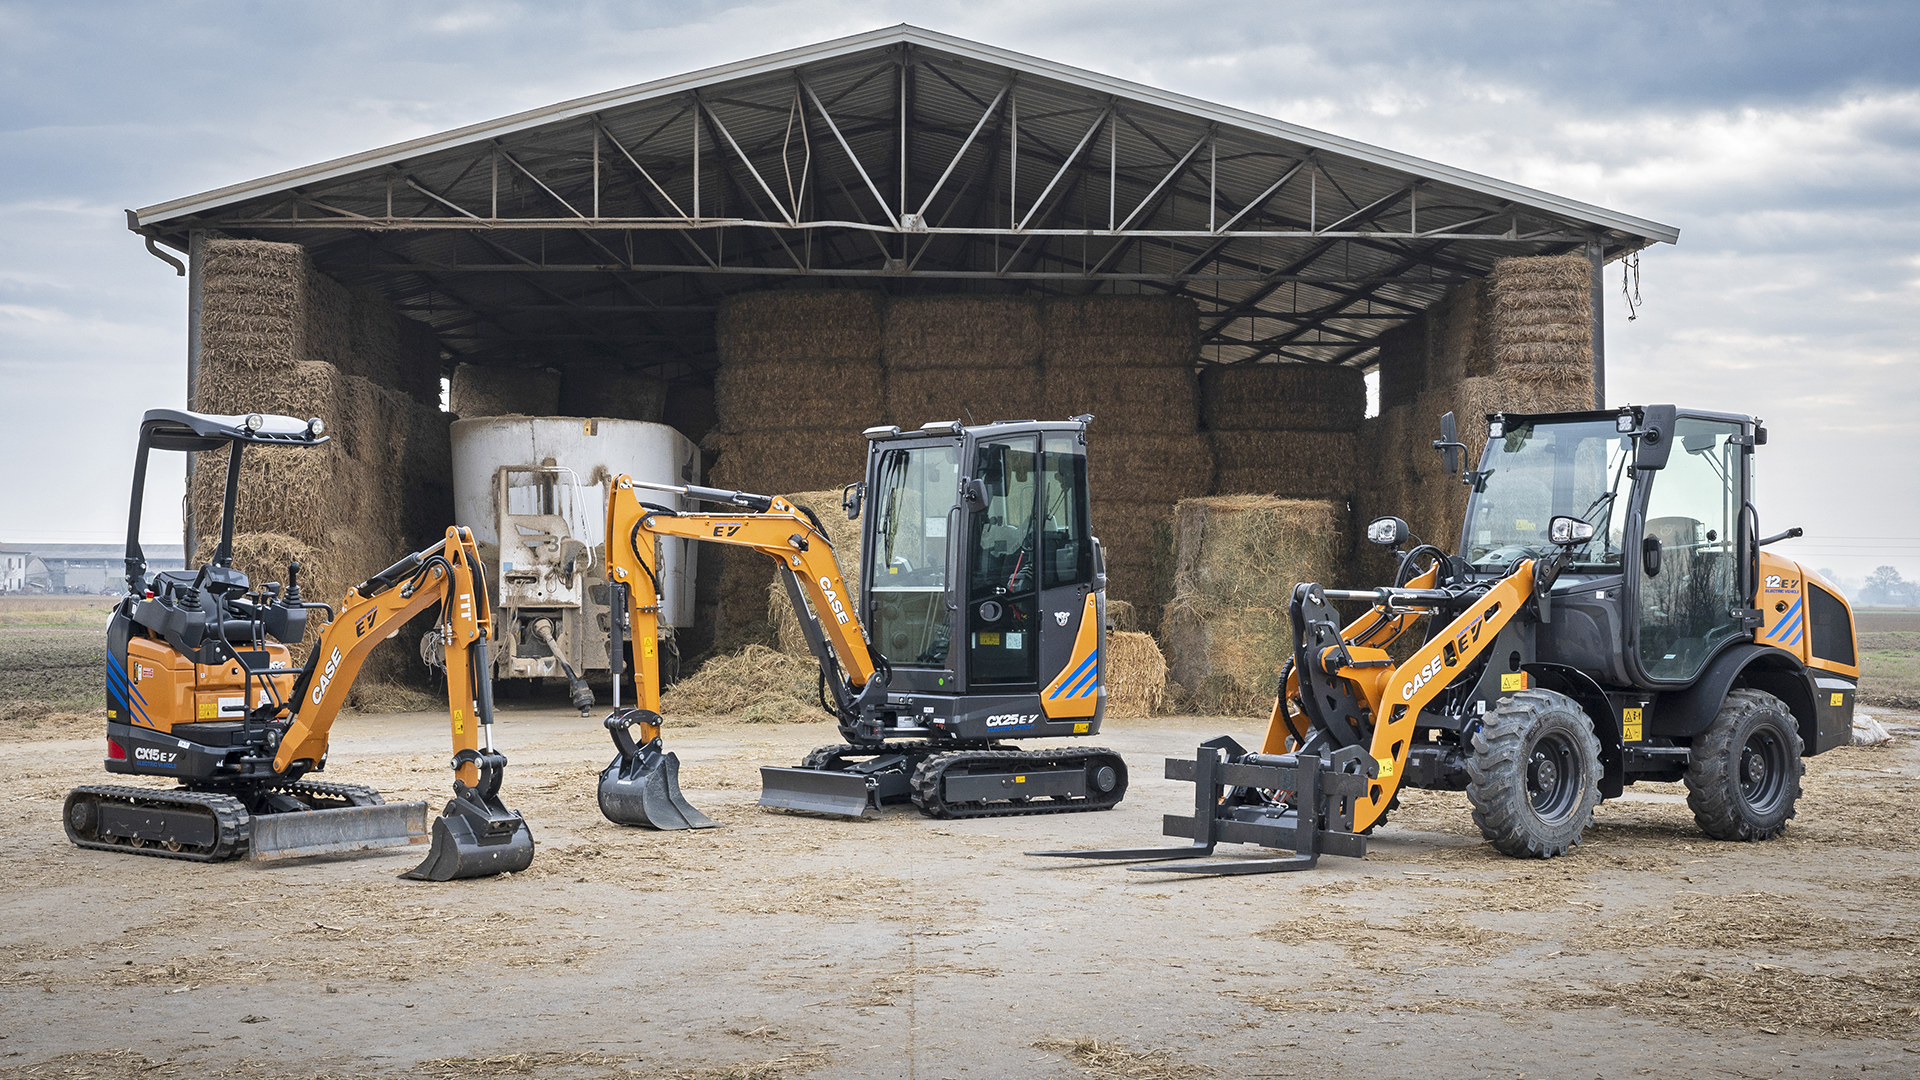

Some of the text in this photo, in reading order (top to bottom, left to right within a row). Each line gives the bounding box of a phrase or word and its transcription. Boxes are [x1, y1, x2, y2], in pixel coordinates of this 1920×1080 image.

[713, 526, 741, 537] EV
[1765, 574, 1781, 588] 12
[819, 575, 850, 625] CASE
[356, 609, 378, 638] EV
[1458, 618, 1483, 654] EV
[312, 645, 342, 705] CASE
[1402, 653, 1442, 701] CASE
[985, 713, 1019, 727] CX25
[135, 747, 160, 761] CX15
